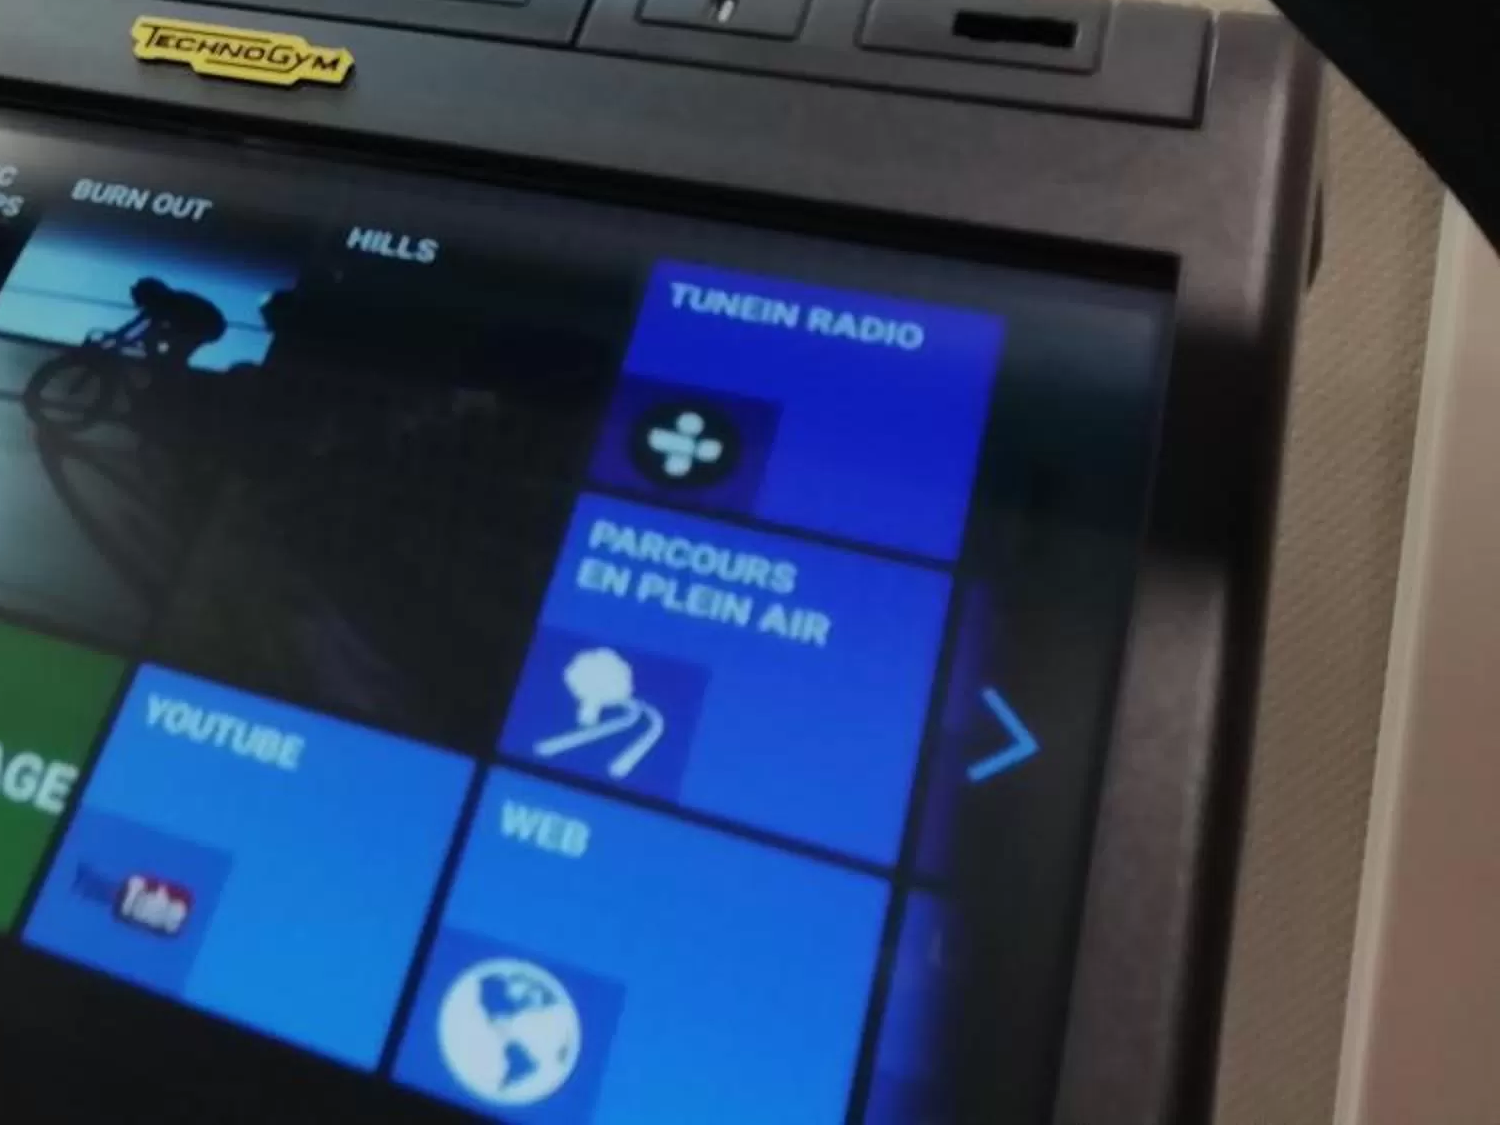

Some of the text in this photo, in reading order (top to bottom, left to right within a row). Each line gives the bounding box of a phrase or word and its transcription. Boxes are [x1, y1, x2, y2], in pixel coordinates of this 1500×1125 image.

[140, 22, 341, 74] TECHNOGYM
[71, 178, 213, 222] BURN OUT
[347, 226, 439, 264] HILLS
[669, 282, 925, 351] TUNEIN RADIO
[590, 520, 798, 594] PARCOURS
[577, 559, 830, 647] EN PLEIN AIR
[146, 694, 304, 770] YOUTUBE
[502, 802, 590, 857] WEB
